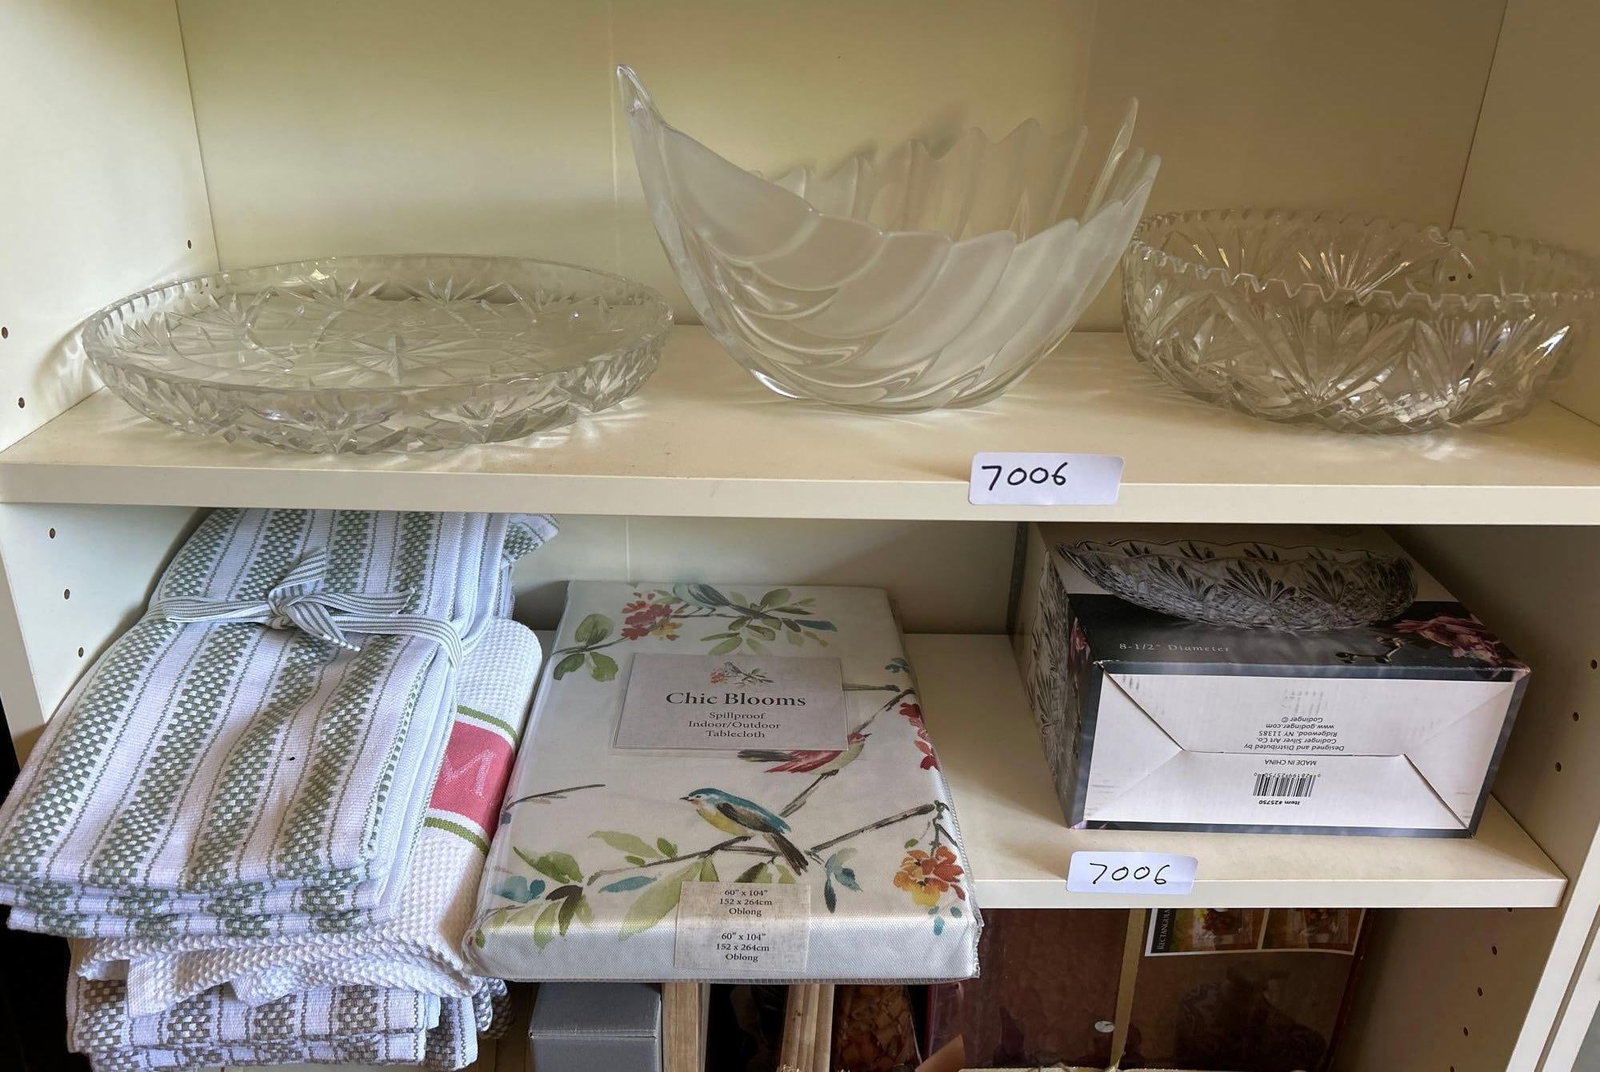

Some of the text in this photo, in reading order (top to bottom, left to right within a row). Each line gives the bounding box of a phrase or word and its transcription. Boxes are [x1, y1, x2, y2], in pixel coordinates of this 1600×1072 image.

[981, 461, 1069, 491] 7006
[1168, 644, 1229, 652] Diameter
[665, 692, 807, 707] Chic Blooms
[709, 712, 766, 721] Spillproof
[688, 720, 782, 730] Indoor/Outdoor
[706, 730, 765, 738] Tablecloth
[1297, 730, 1338, 738] Ridgewood,
[1089, 862, 1170, 885] 7006
[728, 907, 762, 917] Oblong
[740, 943, 770, 952] 264cm
[725, 953, 759, 962] Oblong
